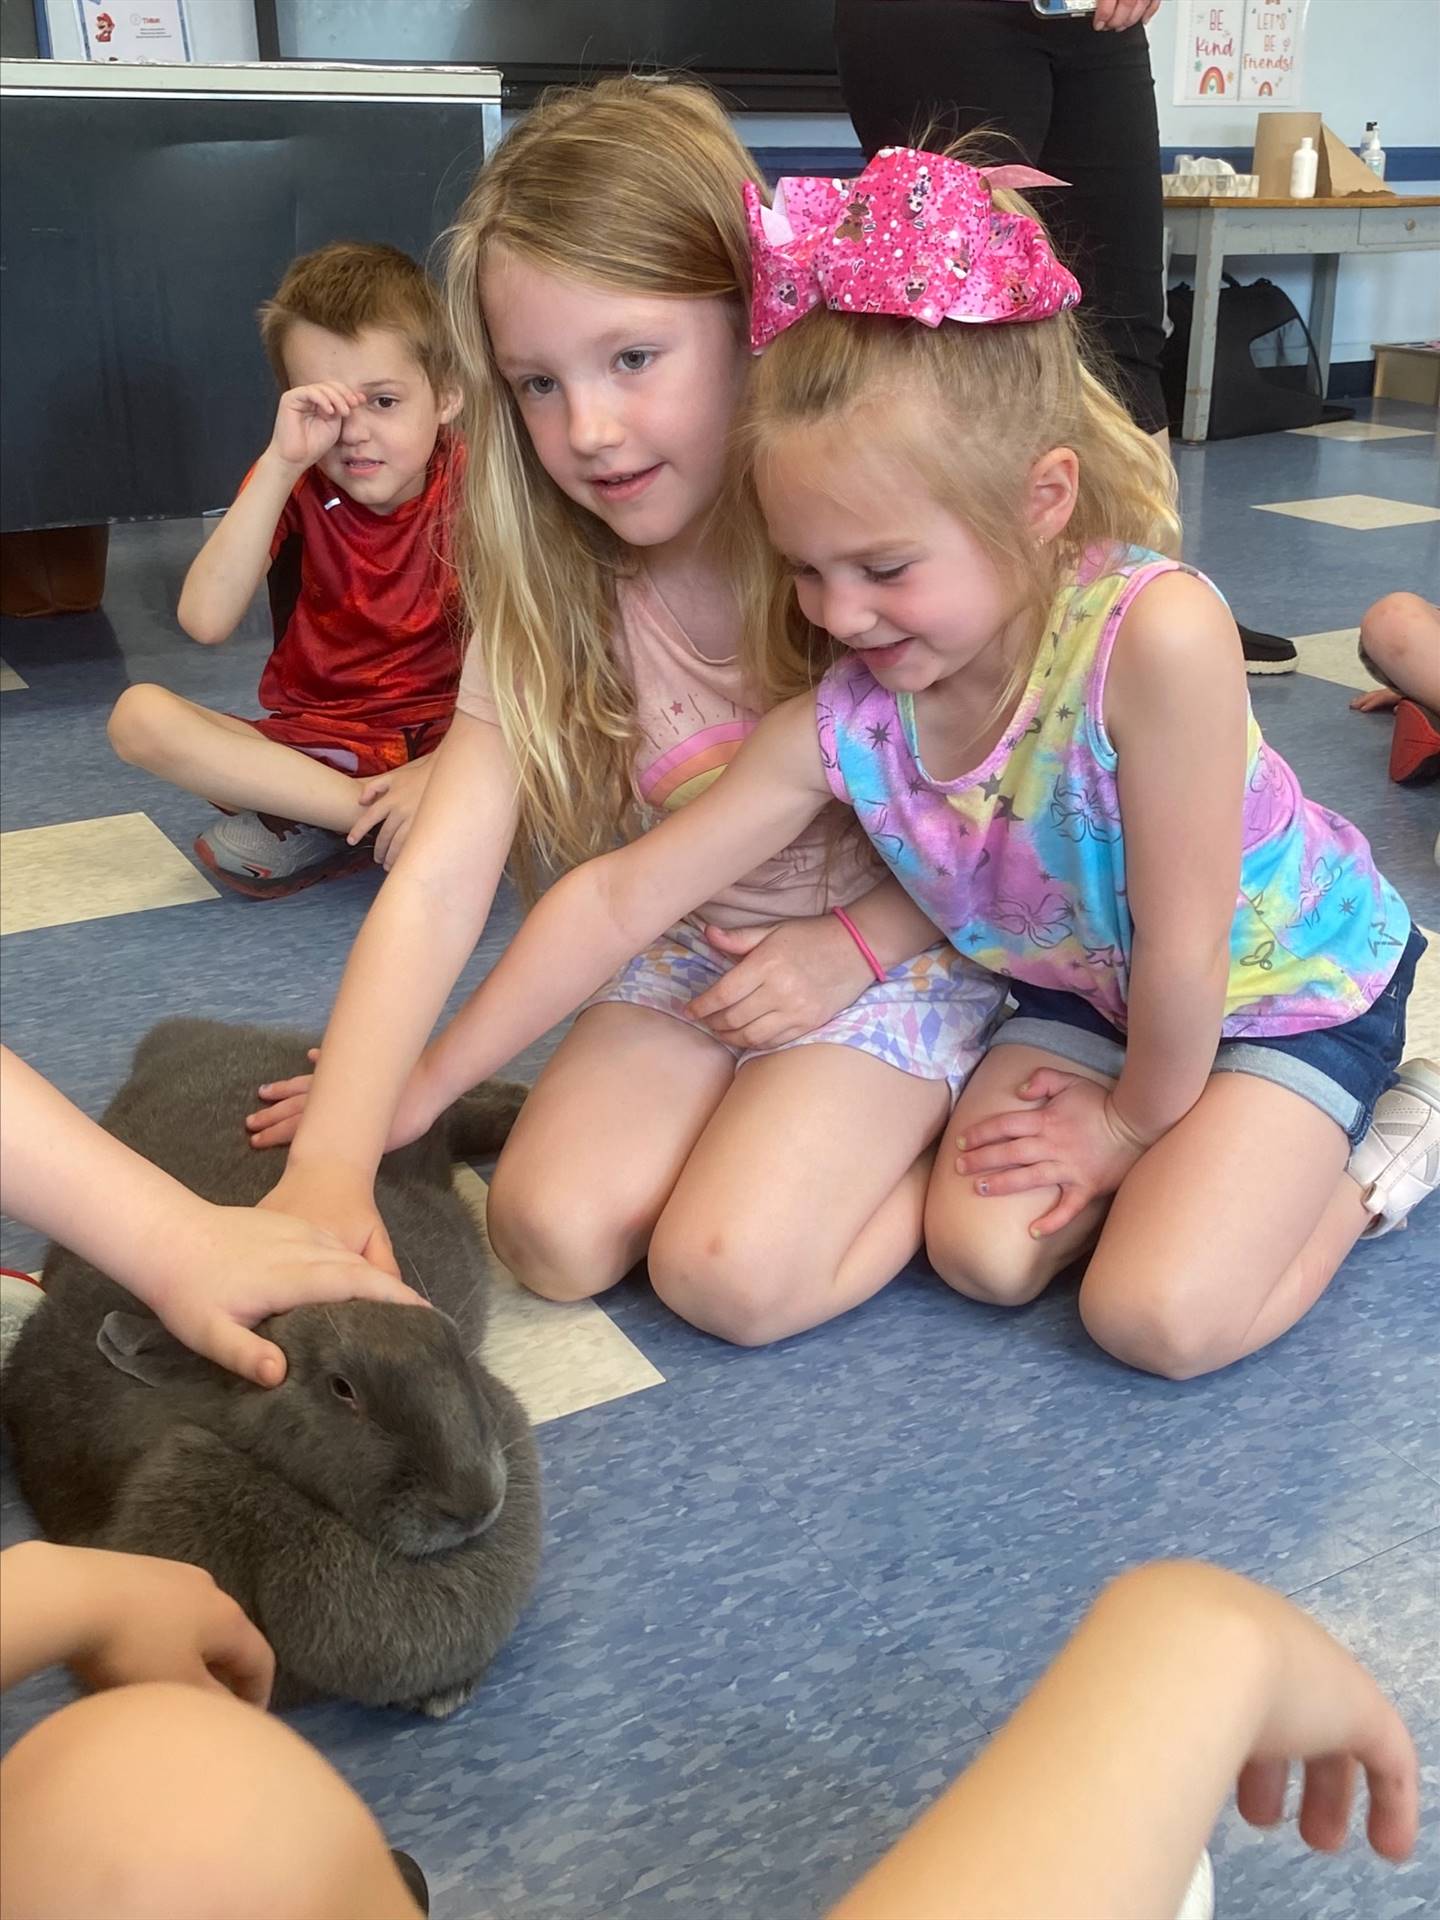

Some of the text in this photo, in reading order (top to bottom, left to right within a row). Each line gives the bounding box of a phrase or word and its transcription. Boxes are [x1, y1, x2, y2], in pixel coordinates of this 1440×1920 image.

[1209, 9, 1224, 31] BE
[1257, 12, 1287, 31] LET'S
[1263, 34, 1276, 52] BE
